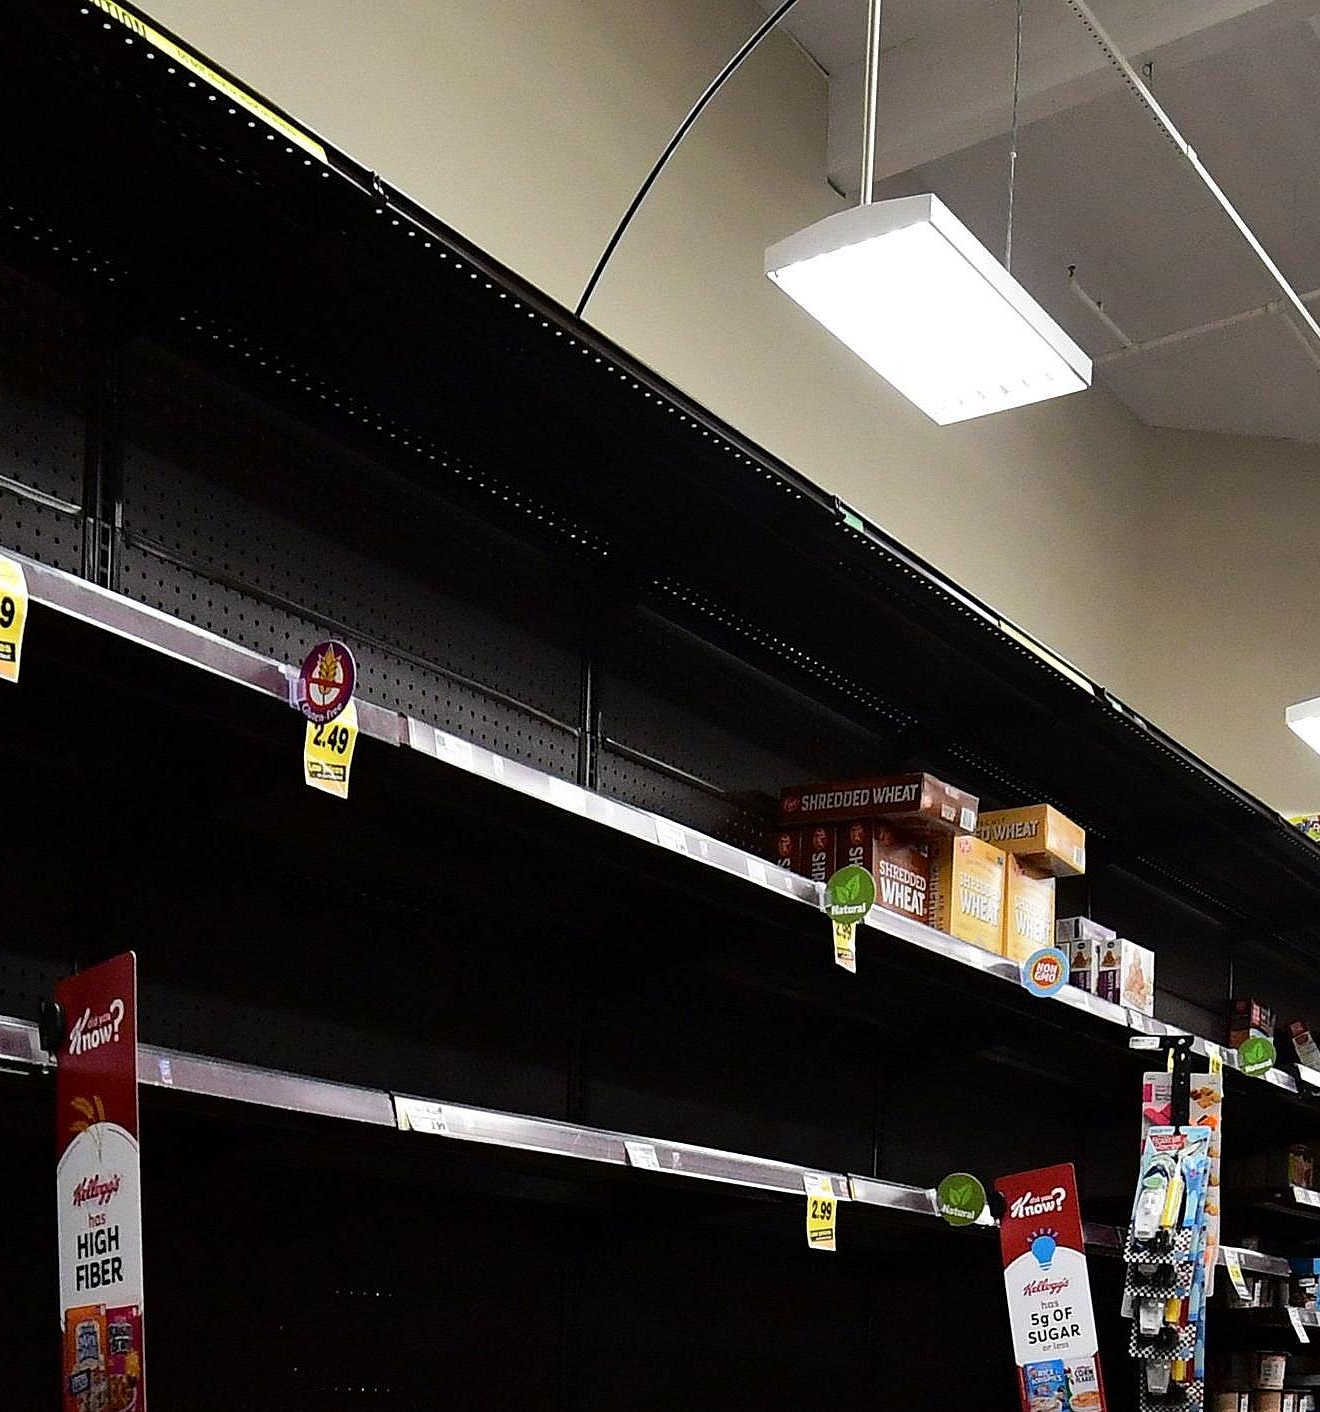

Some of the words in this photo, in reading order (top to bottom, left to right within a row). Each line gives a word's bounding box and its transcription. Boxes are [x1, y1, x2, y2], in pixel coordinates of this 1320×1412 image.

[313, 724, 348, 754] 2.49
[801, 789, 869, 811] SHREDDED
[873, 784, 919, 803] WHEAT
[994, 820, 1040, 841] WHEAT
[880, 860, 926, 891] SHREDDED
[880, 877, 926, 916] WHEAT
[831, 903, 866, 915] Natural
[1034, 972, 1055, 983] GMO
[1037, 962, 1058, 975] NON
[69, 998, 124, 1055] Know?
[72, 1173, 121, 1207] Kellogg's
[812, 1200, 832, 1220] 2.99
[941, 1204, 975, 1220] Natural
[1011, 1187, 1066, 1218] Know?
[88, 1212, 106, 1228] has
[77, 1225, 120, 1260] HIGH
[76, 1257, 123, 1292] FIBER
[1023, 1277, 1069, 1296] Kellogg's
[1040, 1299, 1059, 1311] has
[1030, 1312, 1050, 1329] 5g
[1053, 1307, 1073, 1322] OF
[1028, 1324, 1081, 1345] SUGAR
